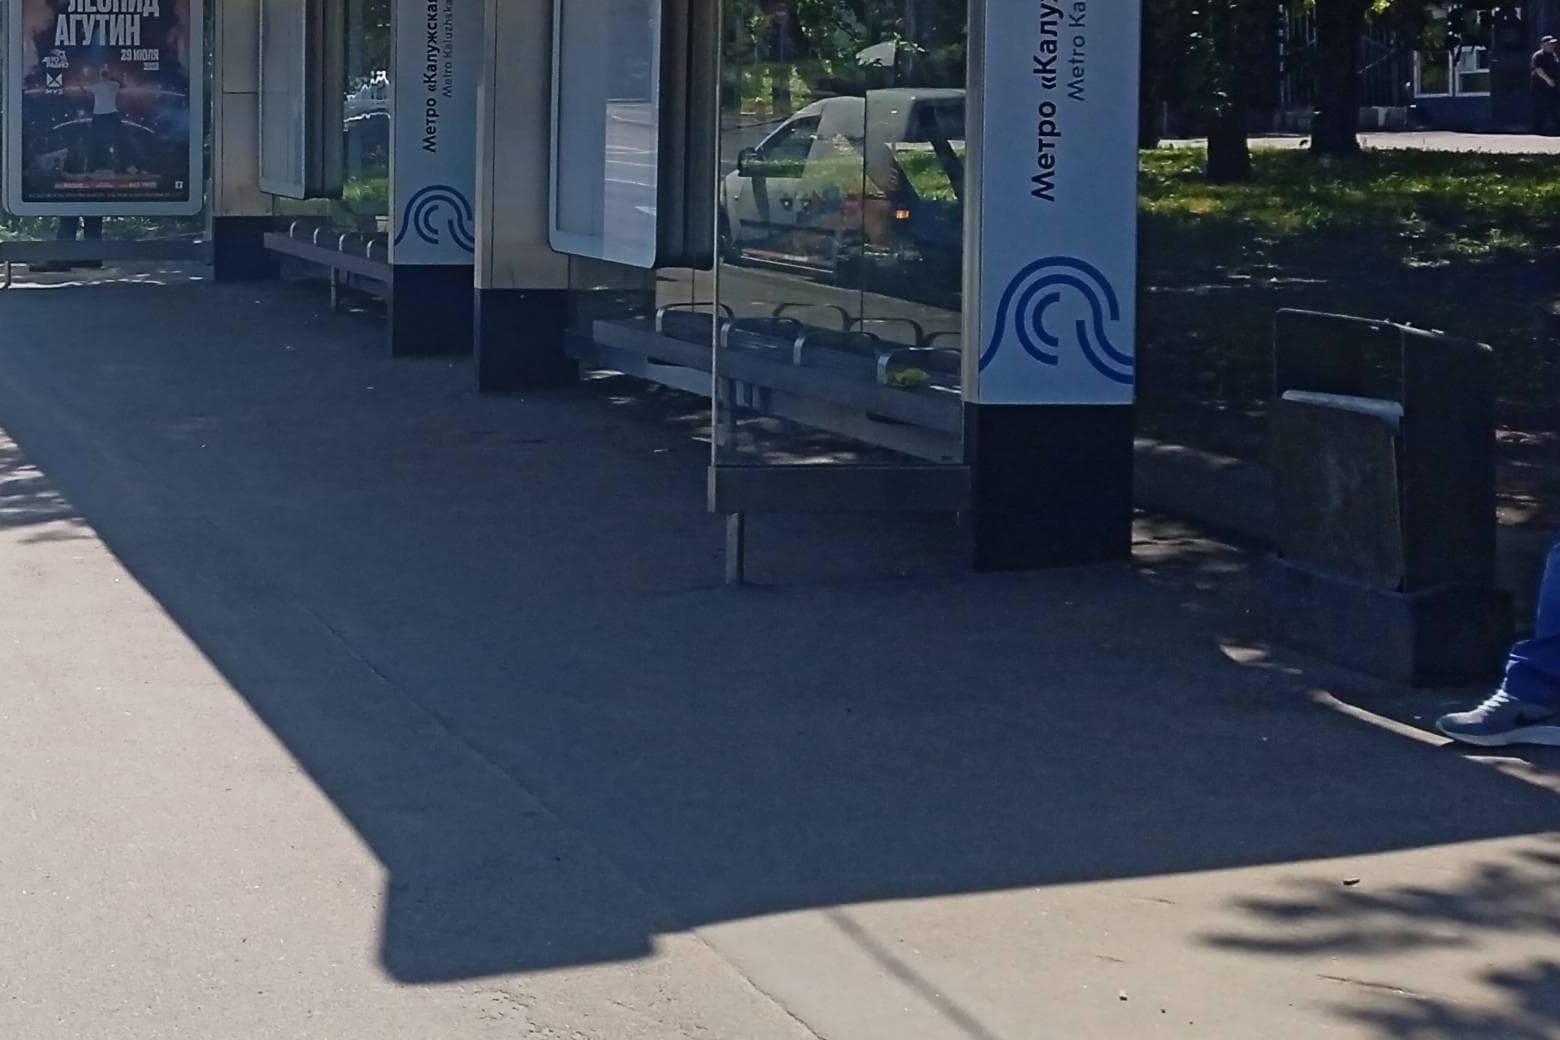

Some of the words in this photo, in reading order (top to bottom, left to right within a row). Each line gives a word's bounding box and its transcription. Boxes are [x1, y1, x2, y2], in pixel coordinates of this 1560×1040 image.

[54, 13, 141, 46] АГУТИН
[120, 48, 133, 61] 29
[1068, 35, 1086, 102] Metro
[442, 61, 453, 98] Metro
[423, 98, 440, 153] Метро
[1032, 101, 1061, 202] Метро
